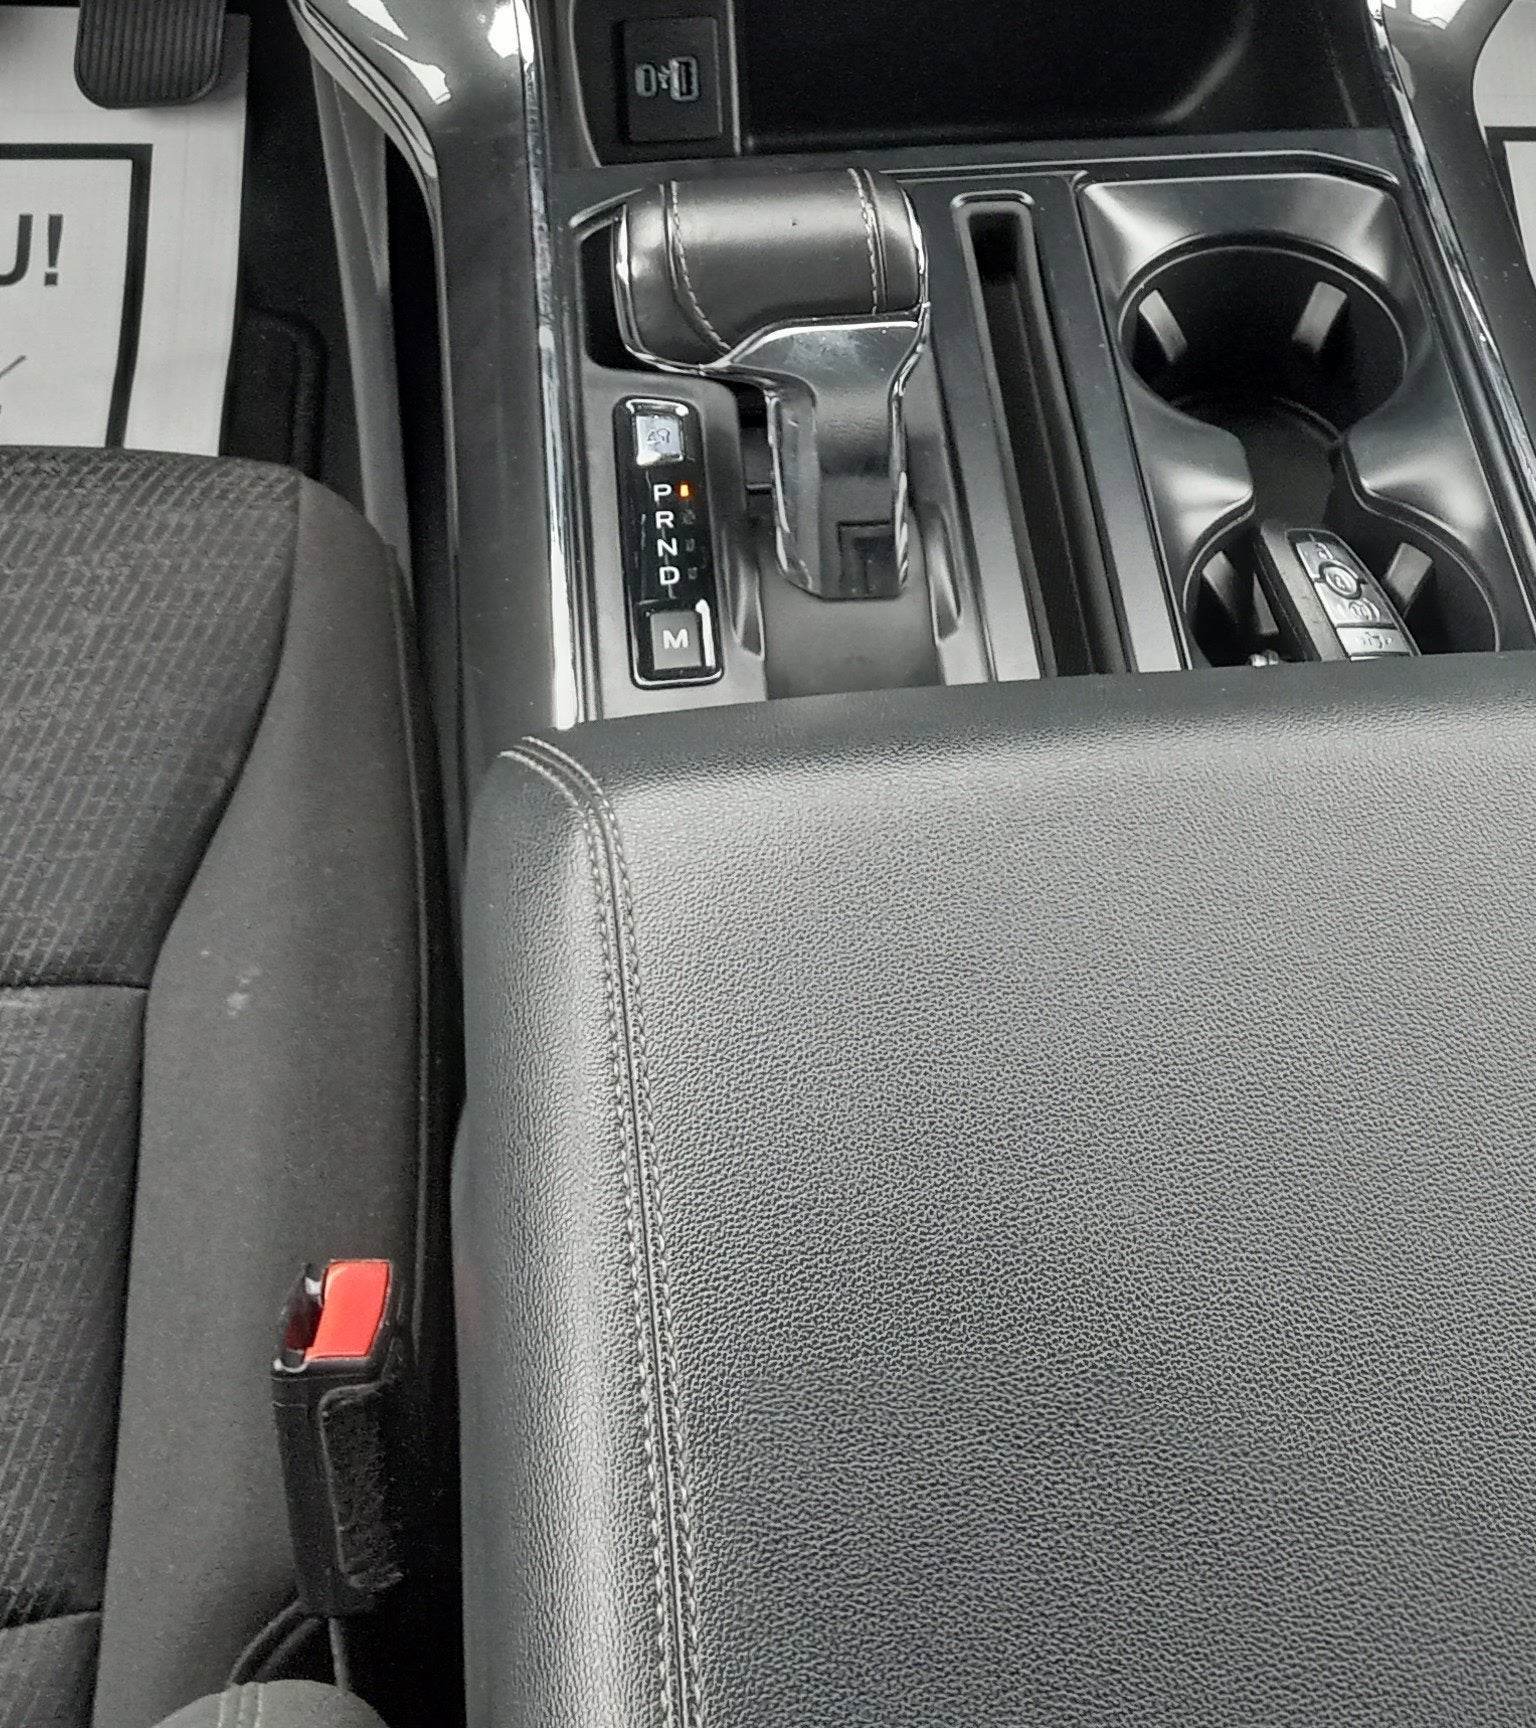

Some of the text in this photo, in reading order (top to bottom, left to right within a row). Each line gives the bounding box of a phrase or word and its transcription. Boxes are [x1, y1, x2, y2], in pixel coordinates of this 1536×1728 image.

[653, 483, 673, 502] P
[655, 511, 674, 529] R
[657, 538, 677, 556] N
[659, 566, 680, 585] D
[664, 630, 689, 648] M
